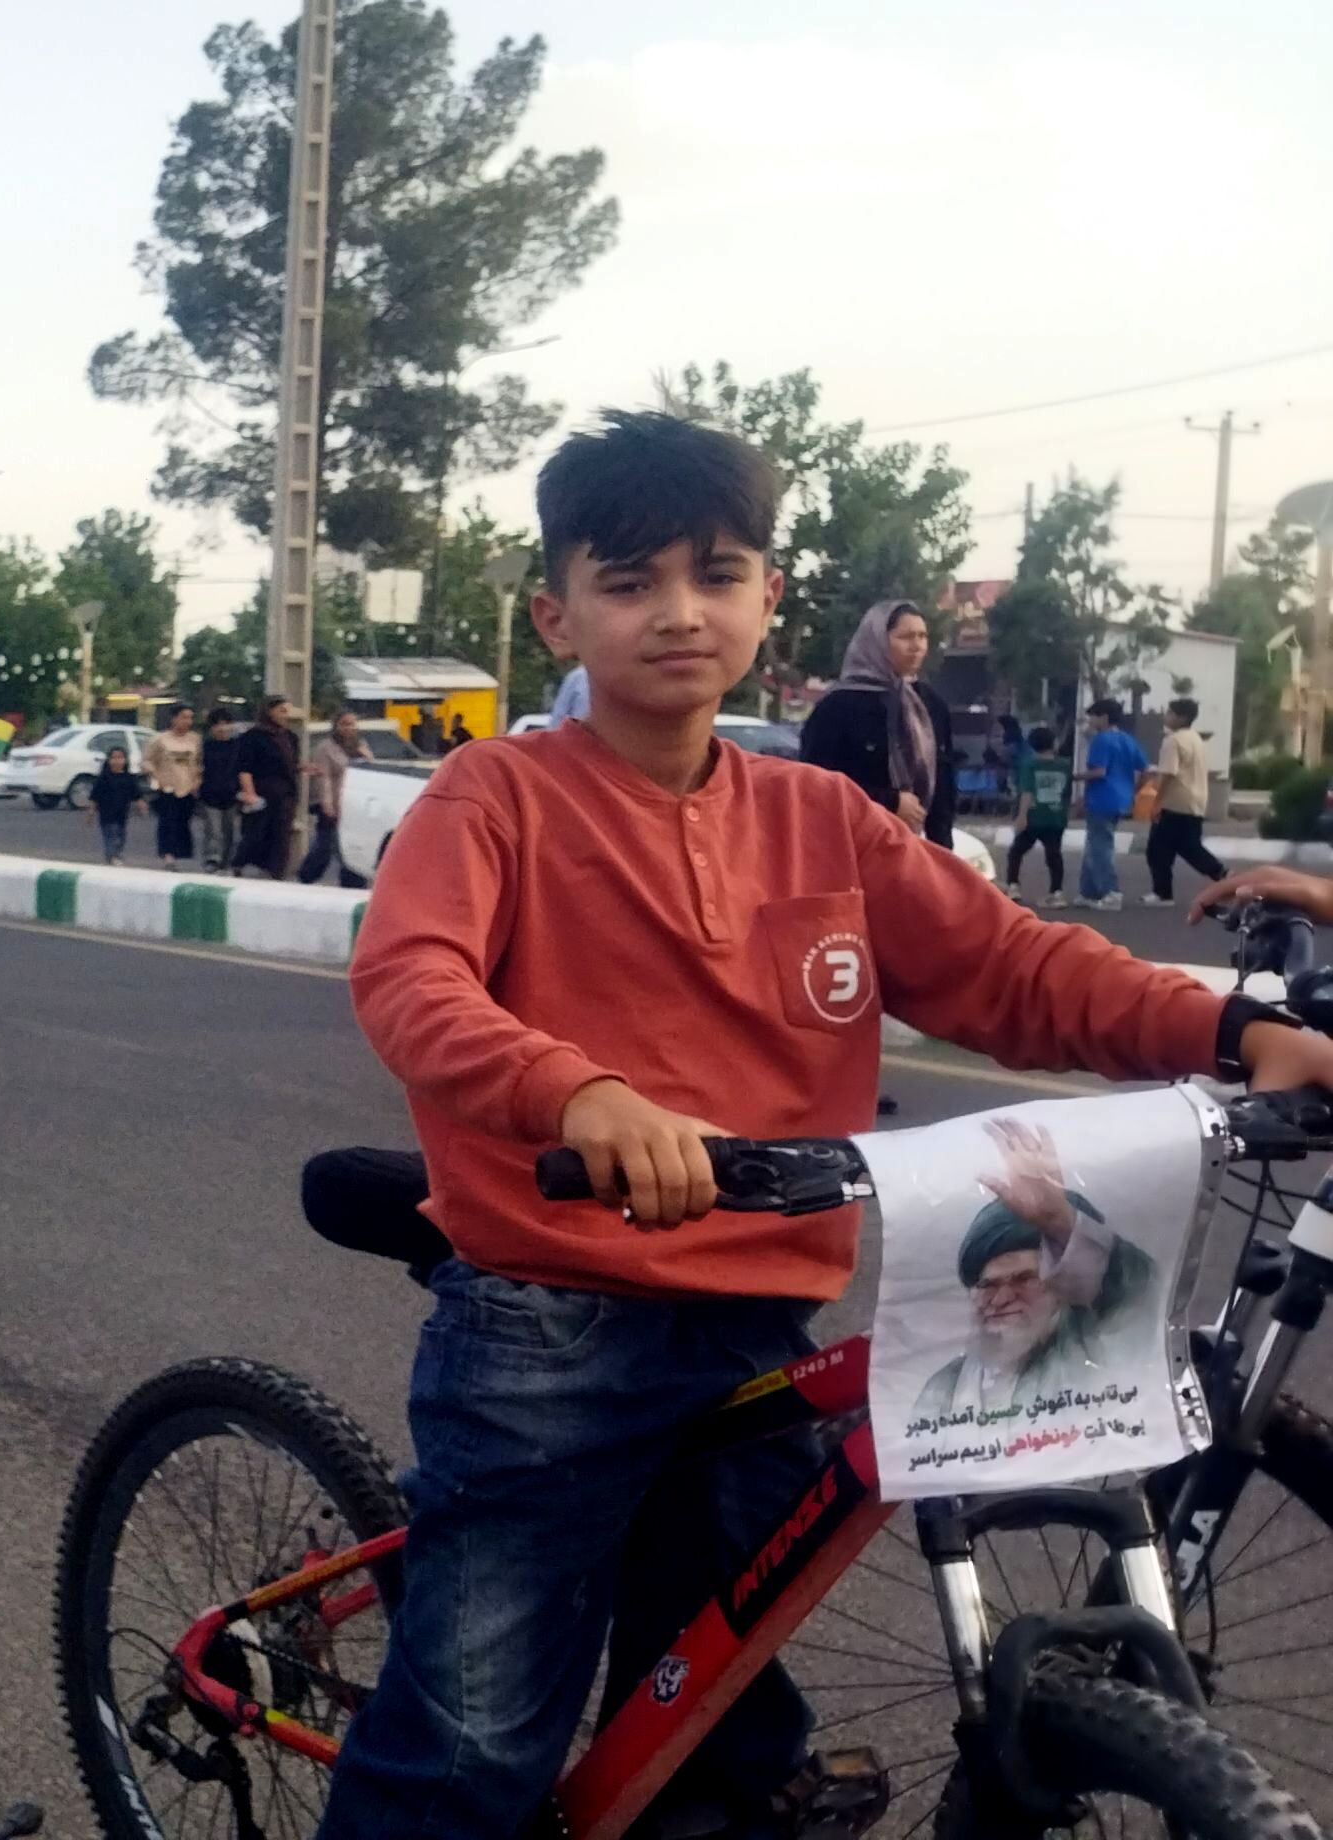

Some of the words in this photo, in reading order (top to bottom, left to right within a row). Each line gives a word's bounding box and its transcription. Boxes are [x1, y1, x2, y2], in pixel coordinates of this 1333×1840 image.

[825, 950, 860, 1002] 3
[939, 1405, 974, 1427] آمده
[976, 1404, 1023, 1427] حسین
[905, 1418, 938, 1438] رهبر
[907, 1447, 958, 1472] سراسر
